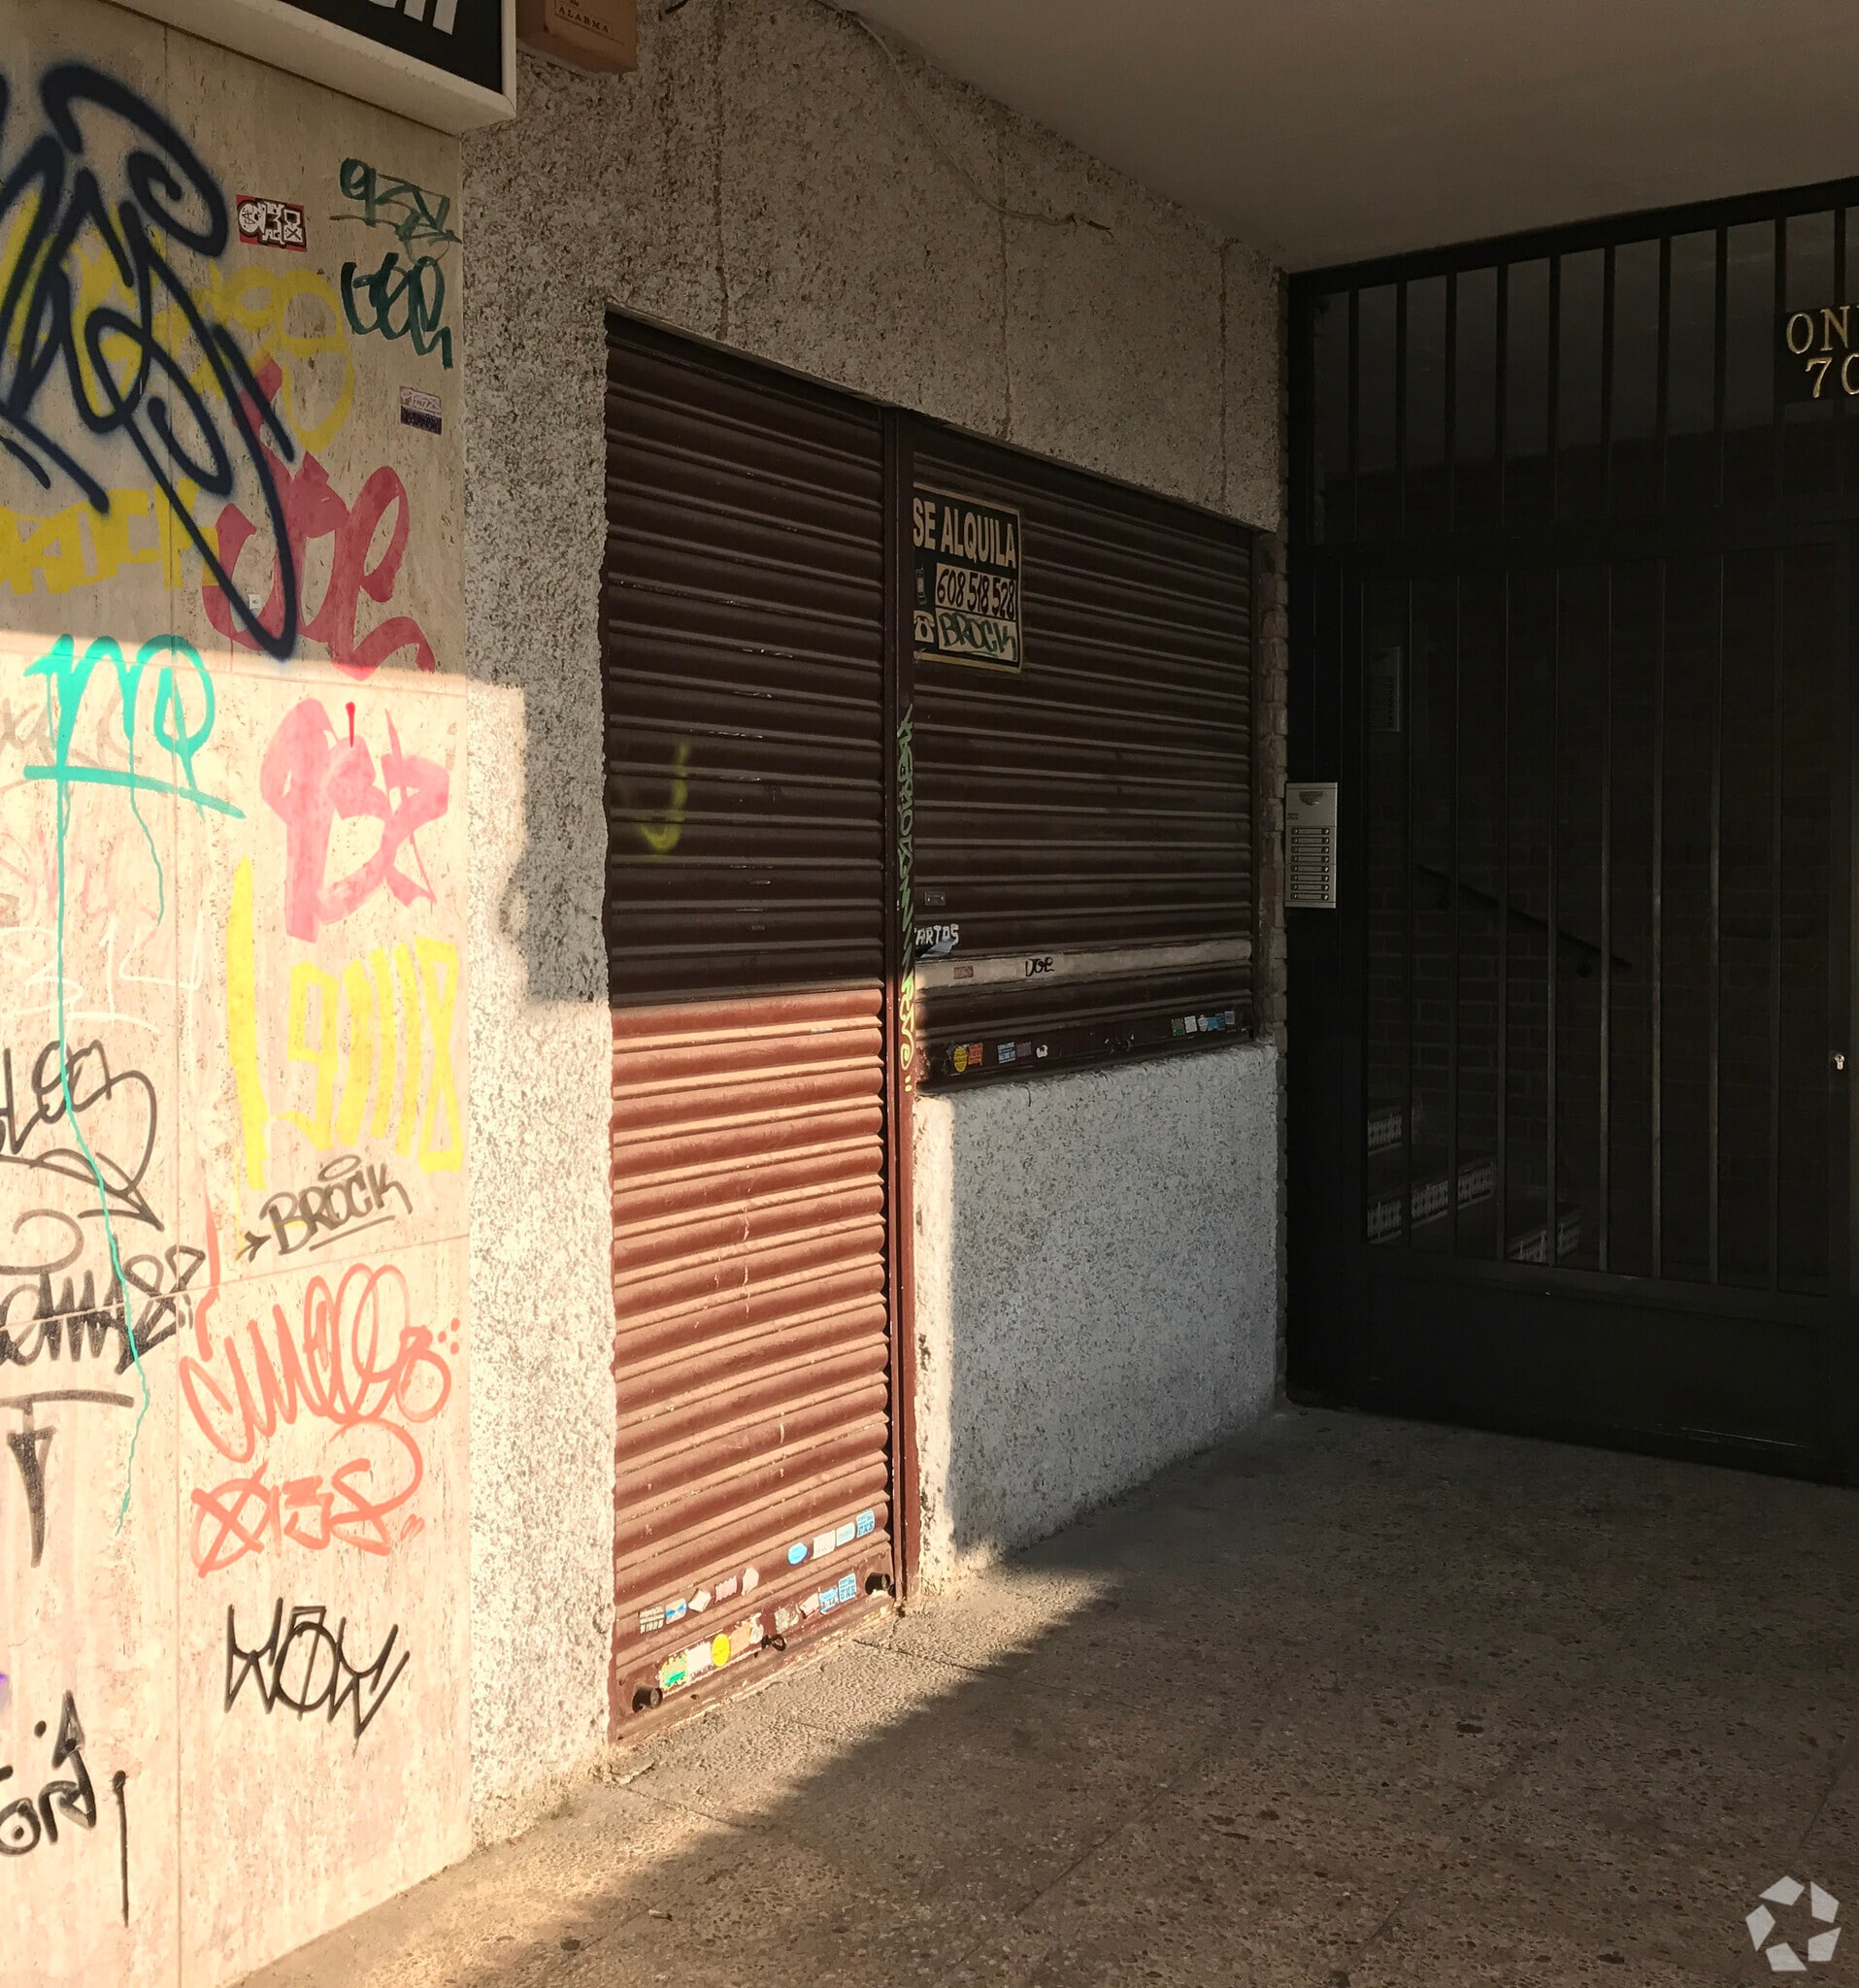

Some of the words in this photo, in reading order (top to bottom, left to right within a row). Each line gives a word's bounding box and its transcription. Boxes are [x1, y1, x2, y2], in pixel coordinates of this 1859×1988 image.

[558, 6, 610, 33] ALARMA
[1786, 305, 1859, 354] ON
[913, 497, 937, 550] SE
[940, 506, 1017, 569] ALQUILA
[937, 568, 966, 608] 608
[992, 577, 1016, 620] 528
[938, 612, 1017, 661] BROCK
[258, 1162, 414, 1255] BROCK
